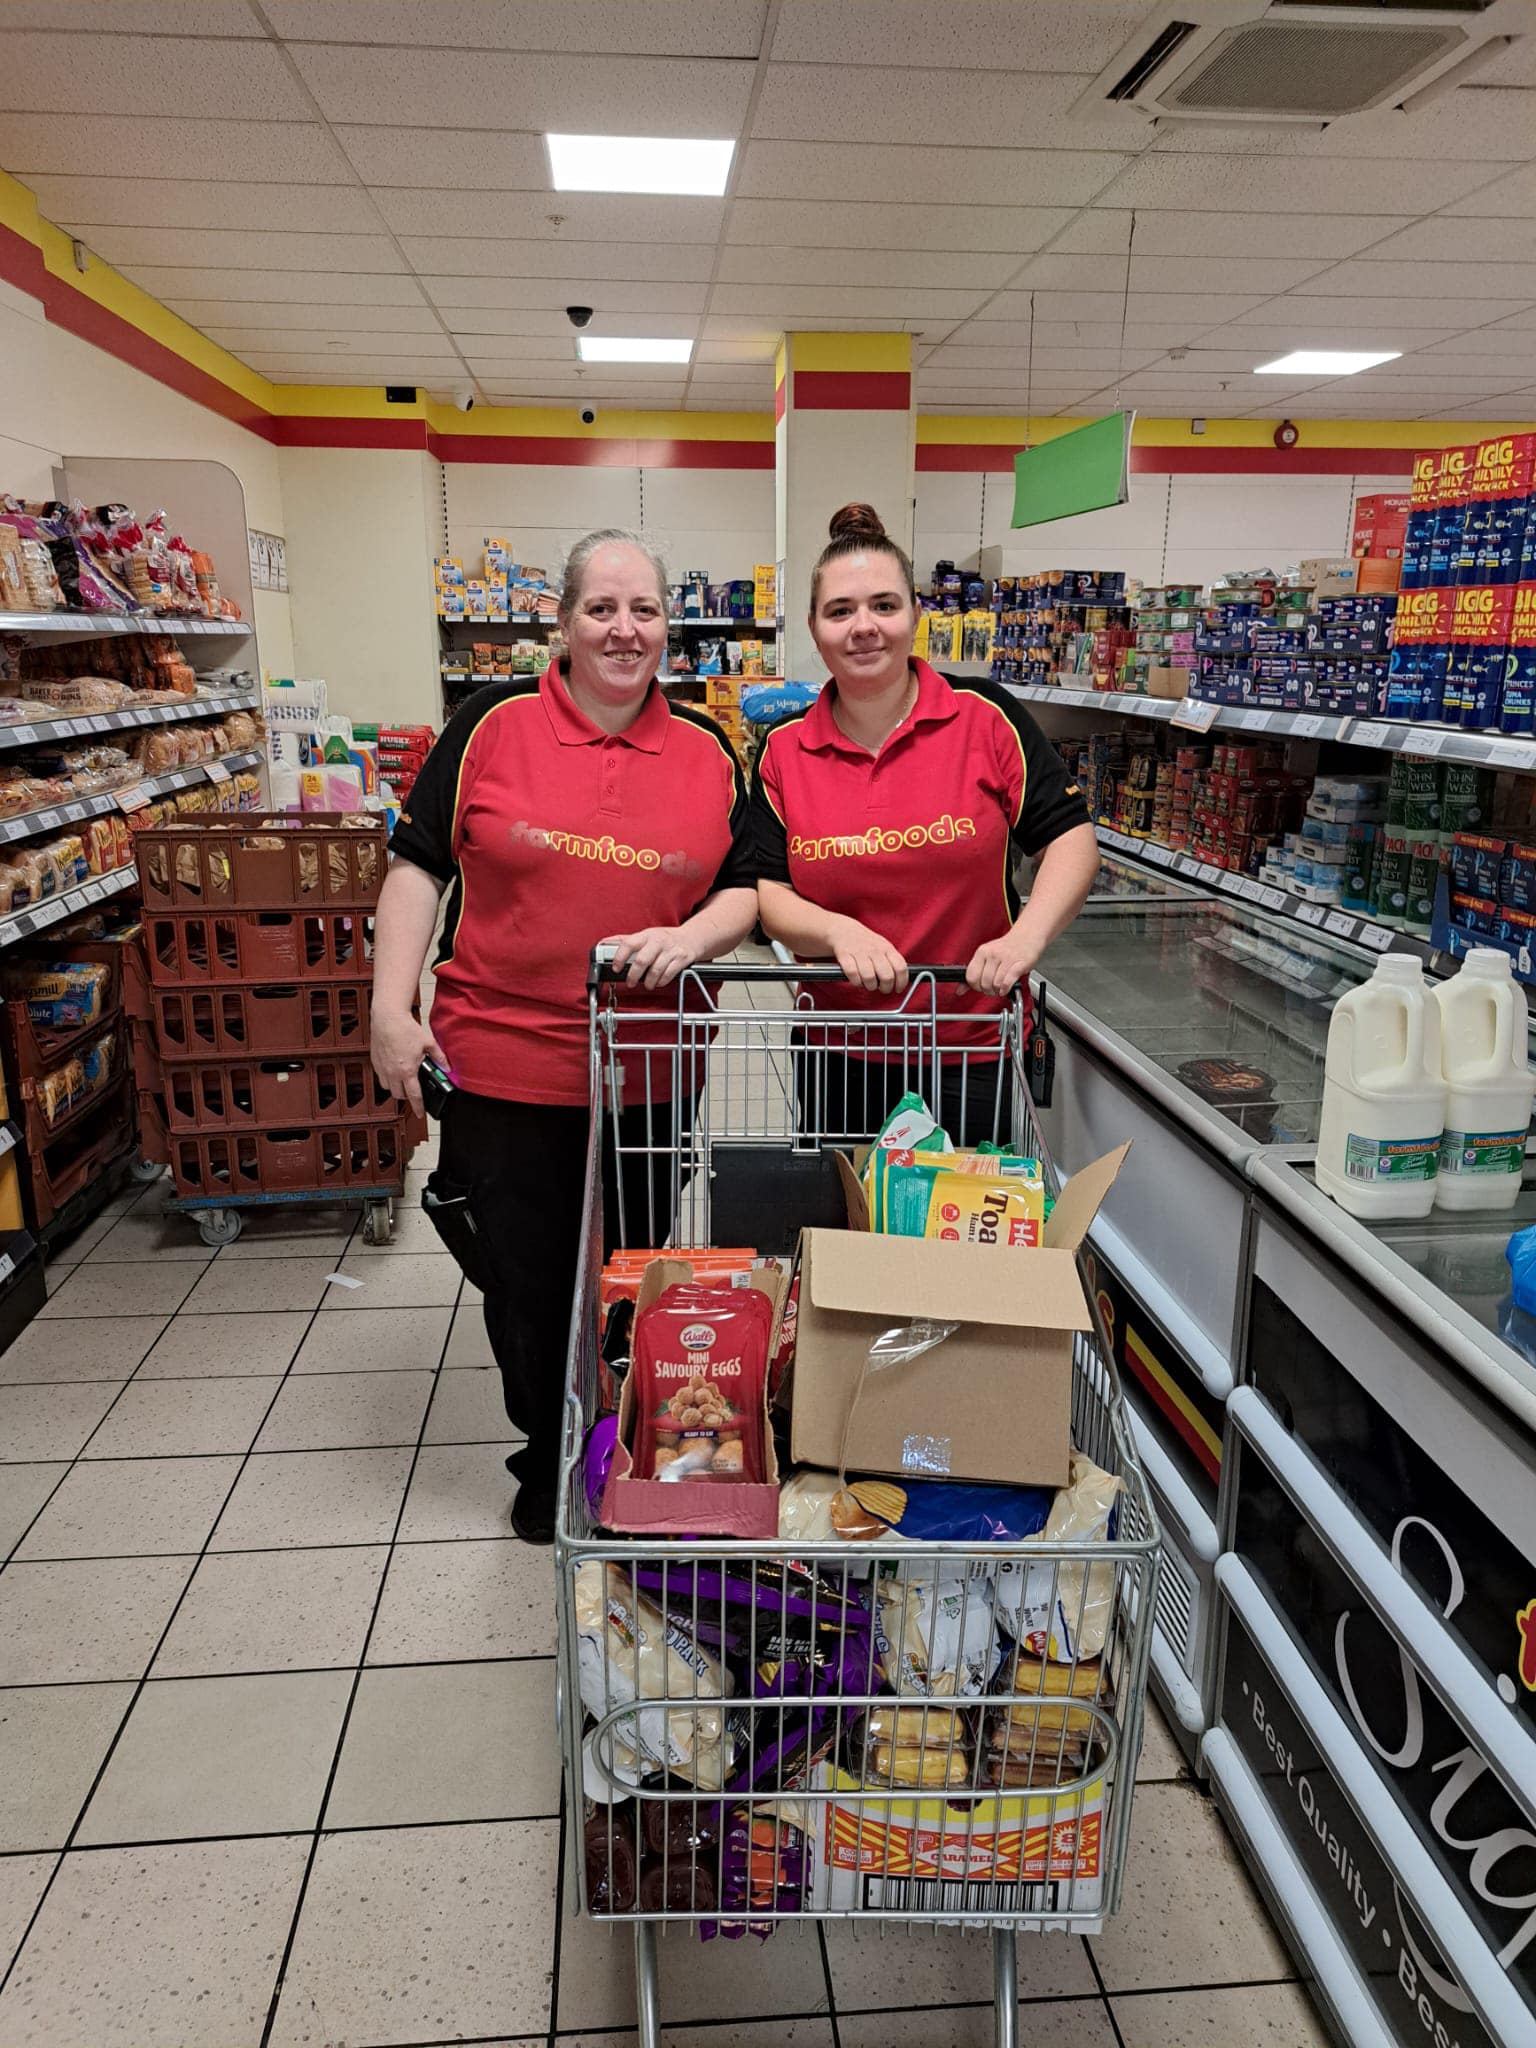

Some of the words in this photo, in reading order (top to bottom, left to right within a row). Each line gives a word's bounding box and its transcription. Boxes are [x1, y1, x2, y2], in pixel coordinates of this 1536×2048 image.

[379, 754, 402, 762] USKY
[380, 772, 402, 780] USKY
[687, 1351, 711, 1364] MINI
[655, 1358, 709, 1378] SAVOURY
[711, 1356, 743, 1377] EGGS
[930, 1853, 995, 1863] CARAMEL
[1252, 1691, 1295, 1788] Best
[1298, 1776, 1376, 1929] Quality
[1398, 1946, 1461, 2048] Bes
